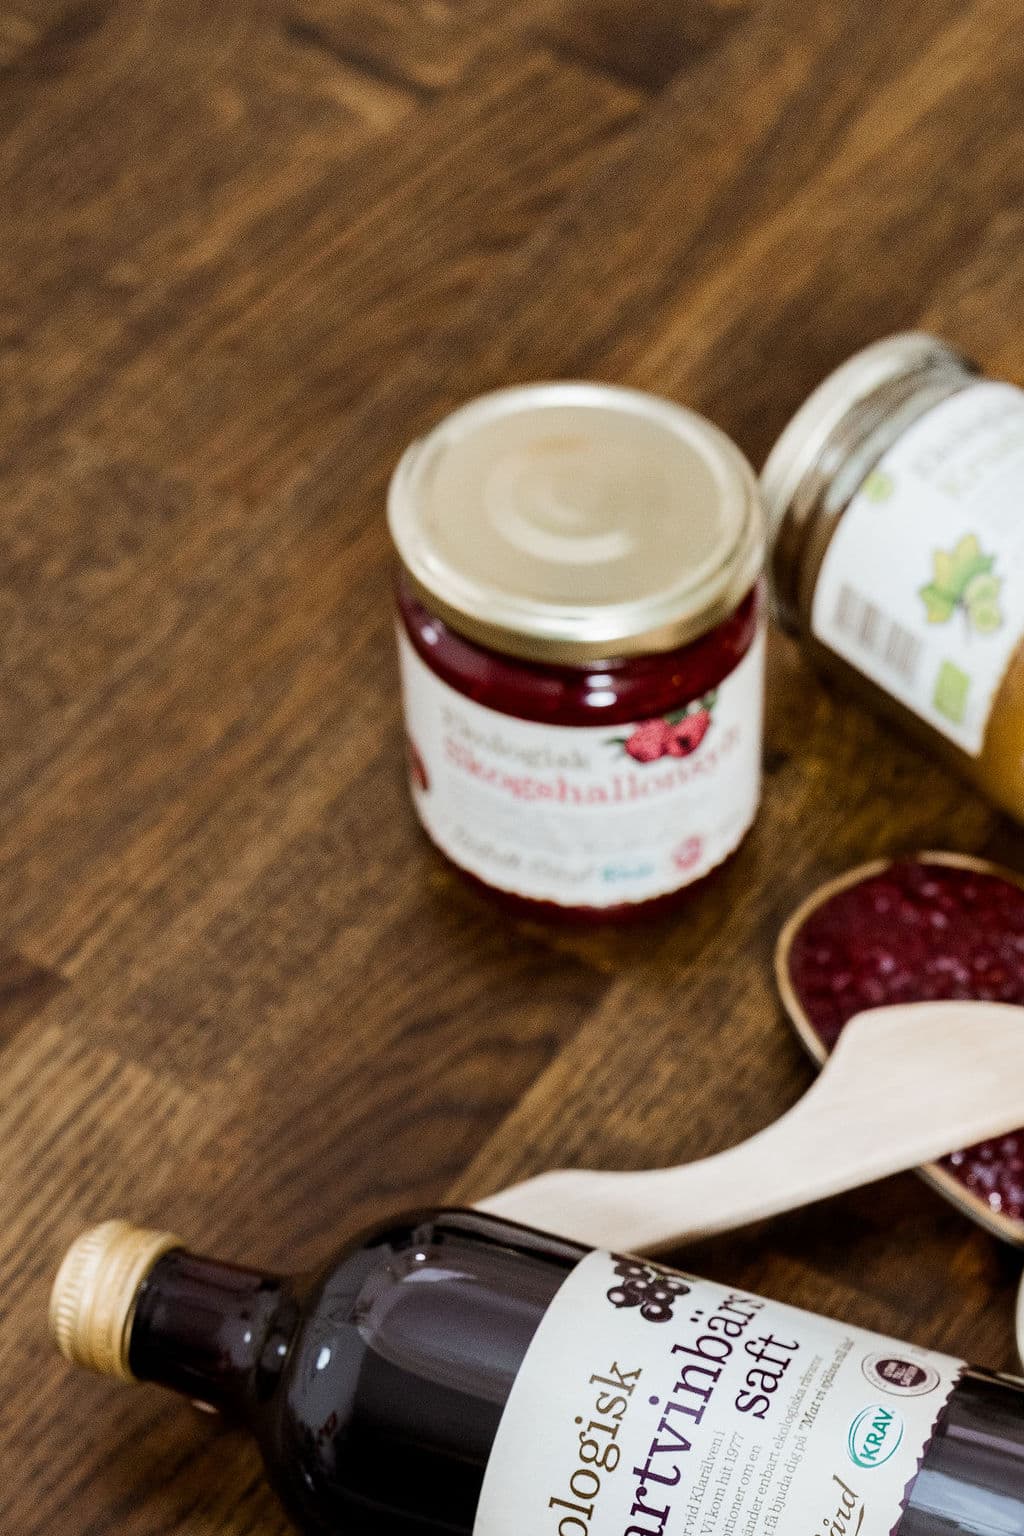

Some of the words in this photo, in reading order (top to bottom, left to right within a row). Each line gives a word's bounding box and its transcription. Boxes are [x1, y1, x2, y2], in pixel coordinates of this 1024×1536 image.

[735, 1336, 800, 1419] saft
[723, 1430, 745, 1464] 1977
[767, 1474, 794, 1514] bjuda
[783, 1450, 803, 1474] dig
[793, 1434, 808, 1453] på
[814, 1388, 827, 1402] vi
[859, 1407, 894, 1461] KRAV
[688, 1437, 724, 1504] Klarälven
[714, 1465, 734, 1487] hit
[739, 1463, 756, 1487] om
[748, 1444, 762, 1462] en
[757, 1451, 781, 1496] enbart
[685, 1503, 700, 1526] vid
[704, 1487, 727, 1520] kom
[699, 1518, 716, 1535] Vi
